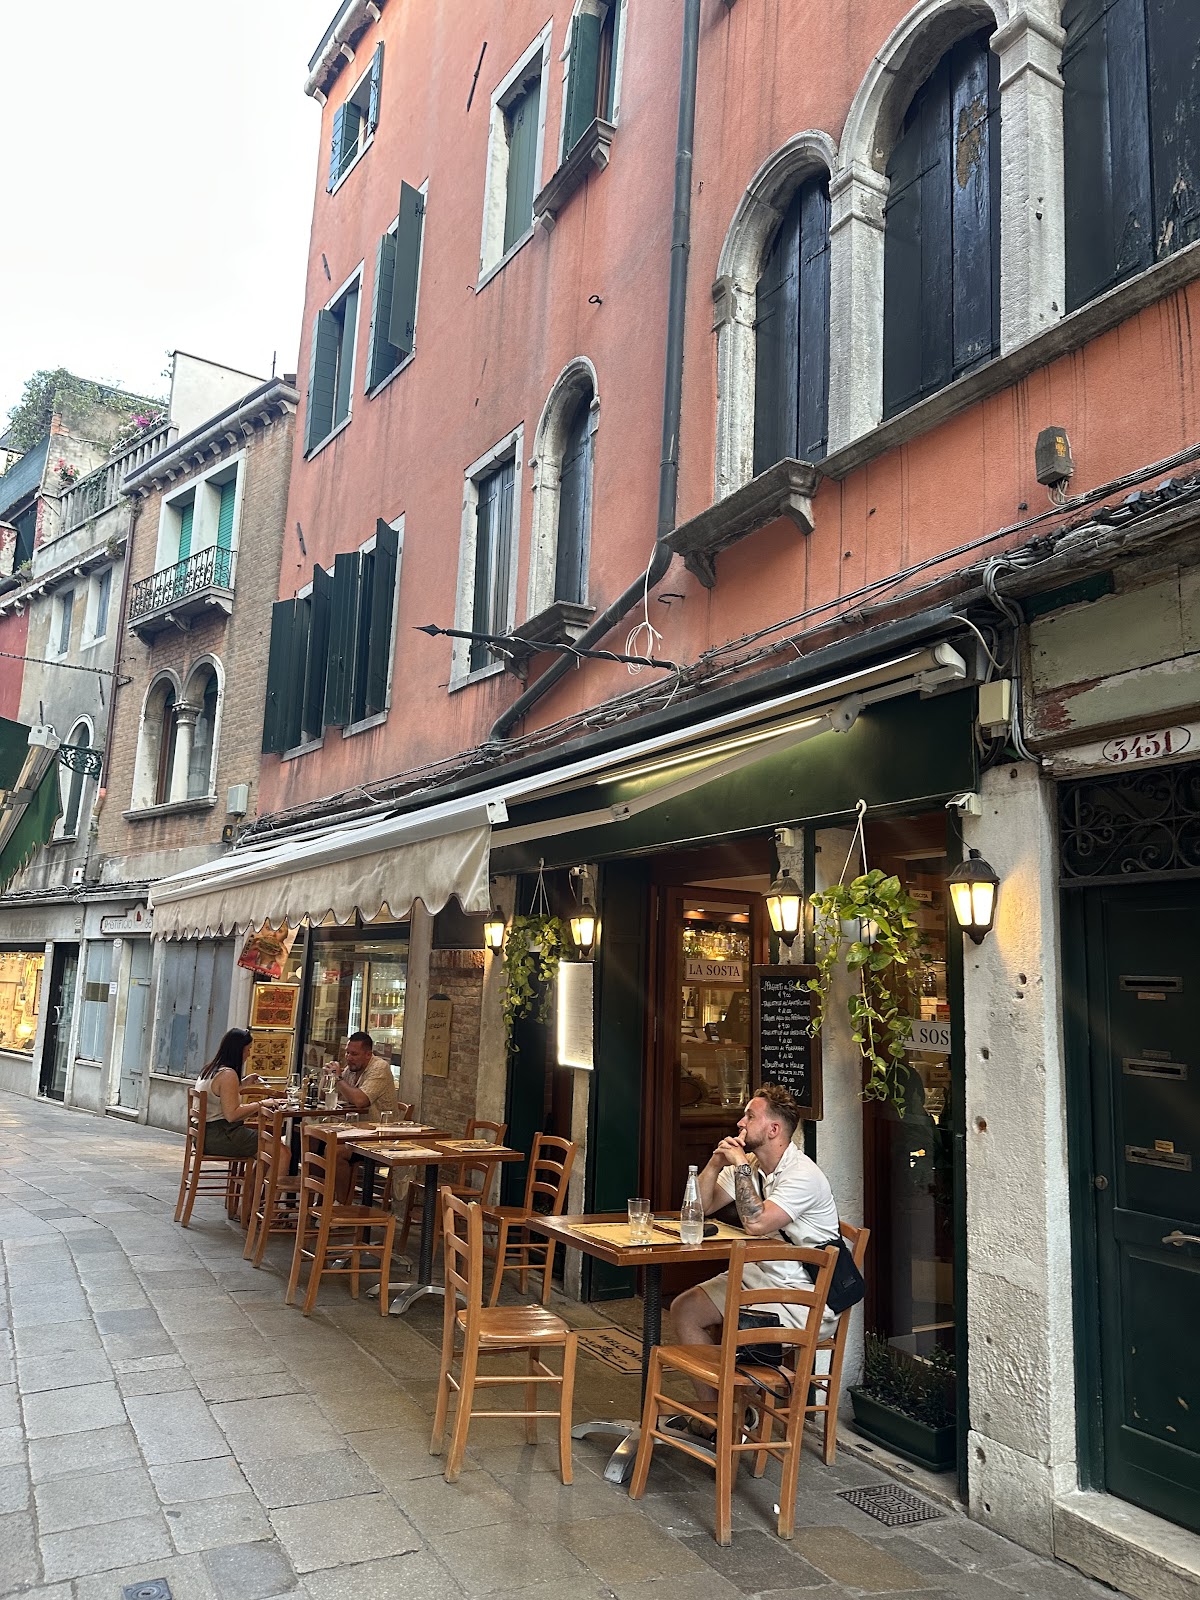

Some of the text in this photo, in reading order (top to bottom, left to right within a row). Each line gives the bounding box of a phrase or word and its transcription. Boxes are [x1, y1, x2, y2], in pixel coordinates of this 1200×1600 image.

[1112, 730, 1172, 762] 3451
[689, 963, 741, 977] LA SOSTA
[920, 1028, 950, 1046] SOS
[597, 1334, 642, 1362] WELCOM
